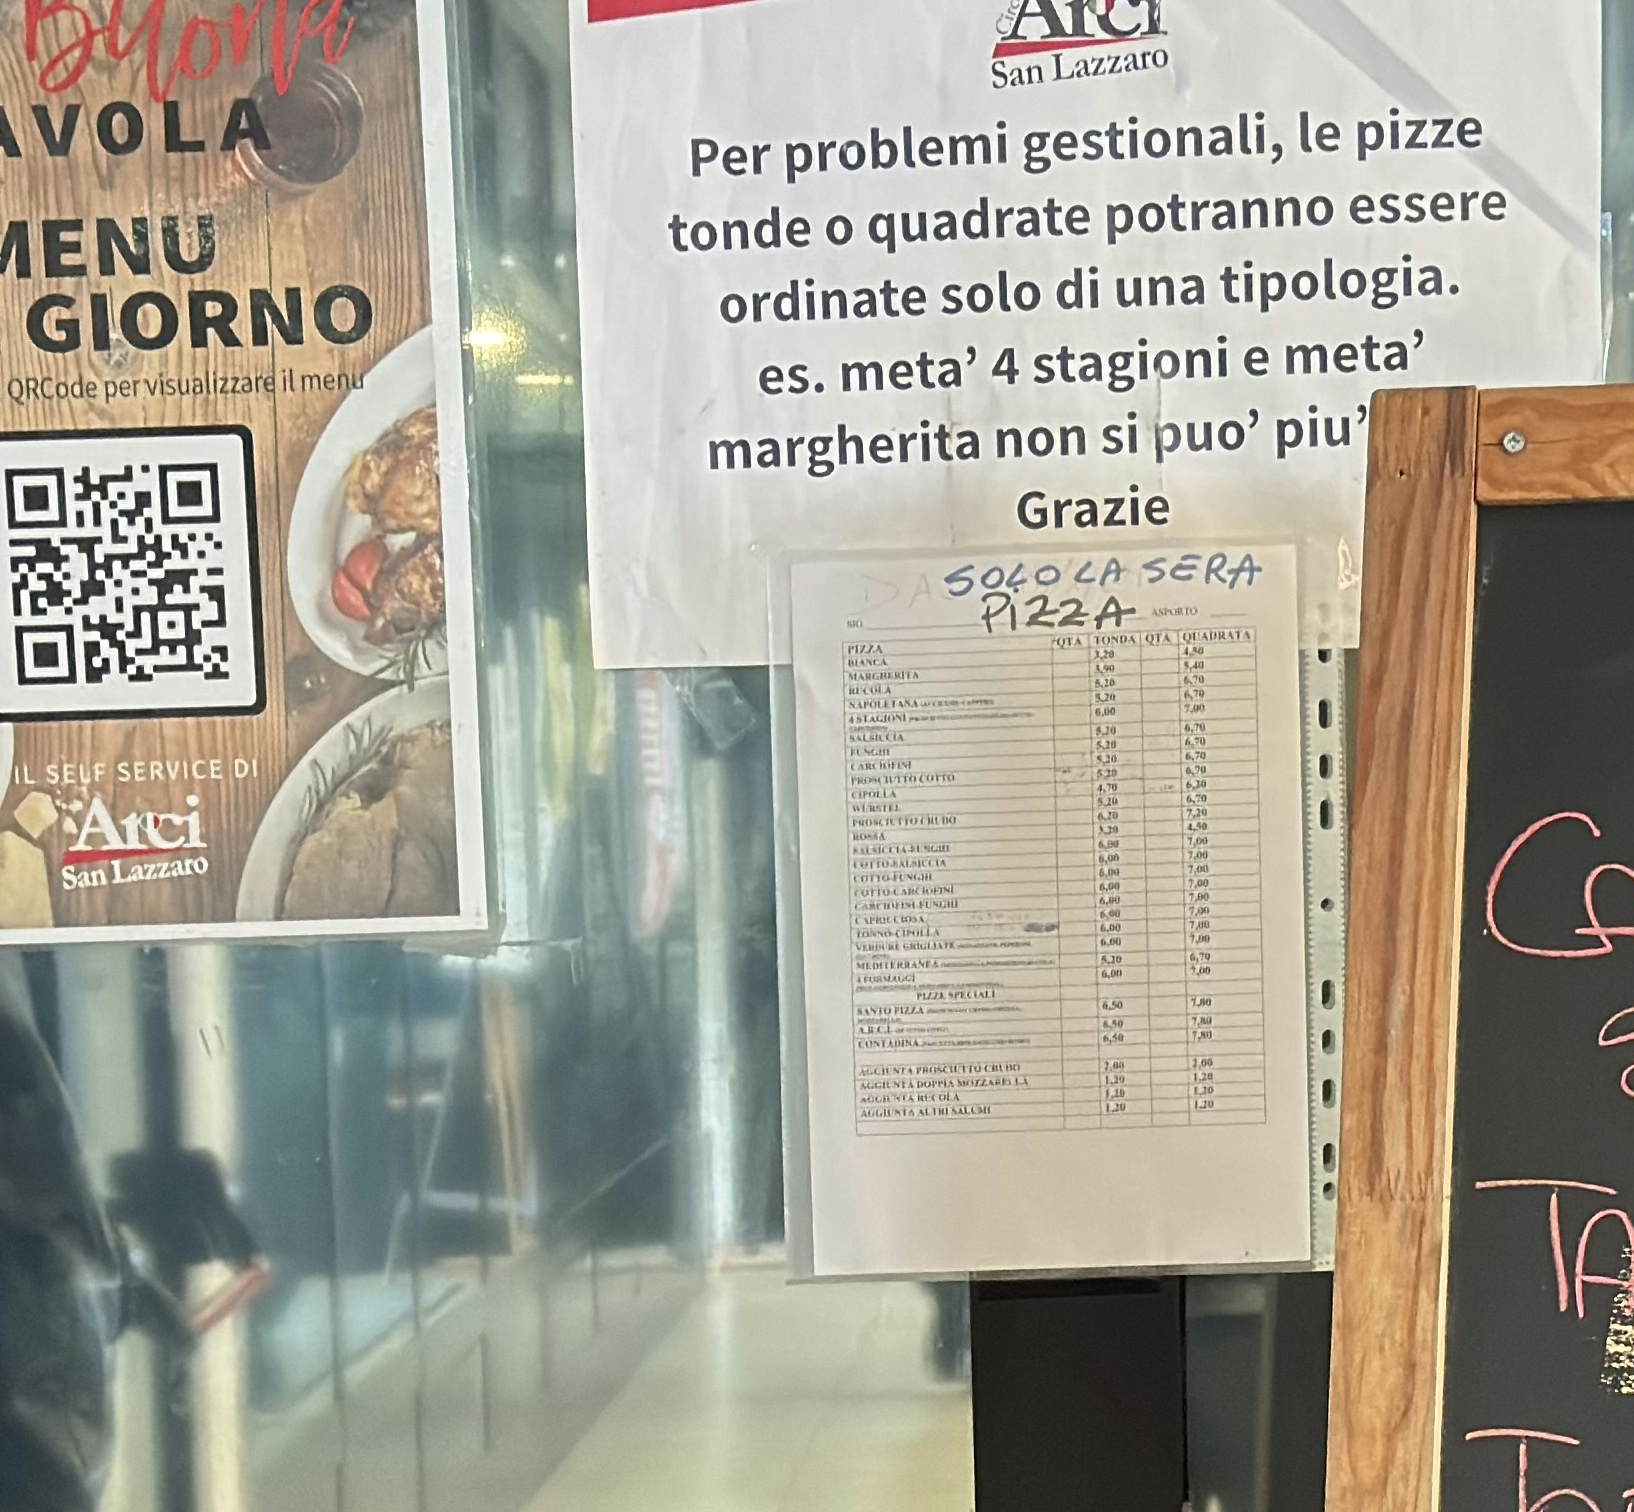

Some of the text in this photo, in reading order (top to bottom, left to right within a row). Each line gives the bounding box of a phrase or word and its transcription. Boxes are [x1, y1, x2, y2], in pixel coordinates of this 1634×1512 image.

[991, 48, 1168, 89] San Lazzaro
[690, 107, 1483, 184] Per problemi gestionali, le pizze
[667, 189, 1507, 254] tonde o quadrate potranno essere
[719, 254, 1460, 324] ordinate solo di una tipologia.
[26, 285, 373, 354] GIORNO
[758, 328, 1424, 395] es. meta' 4 stagioni e meta'
[8, 369, 365, 405] QRCode per visualizzare il menu
[708, 404, 1367, 478] margherita non si puo' piu'
[1017, 484, 1170, 530] Grazie
[944, 552, 1263, 597] SOLO LA SERA
[981, 590, 1136, 634] PIZZA
[1152, 607, 1199, 617] ASPORTO
[848, 644, 883, 654] PIZZA
[1093, 635, 1136, 645] TONDA
[1145, 633, 1171, 644] QTA
[1183, 630, 1251, 642] QUADRATA
[849, 671, 919, 681] MARGHERITA
[849, 699, 918, 709] NAPOLETANA
[14, 758, 259, 785] IL SELF SERVICE DI
[69, 792, 208, 851] Arci
[62, 855, 209, 890] San Lazzaro
